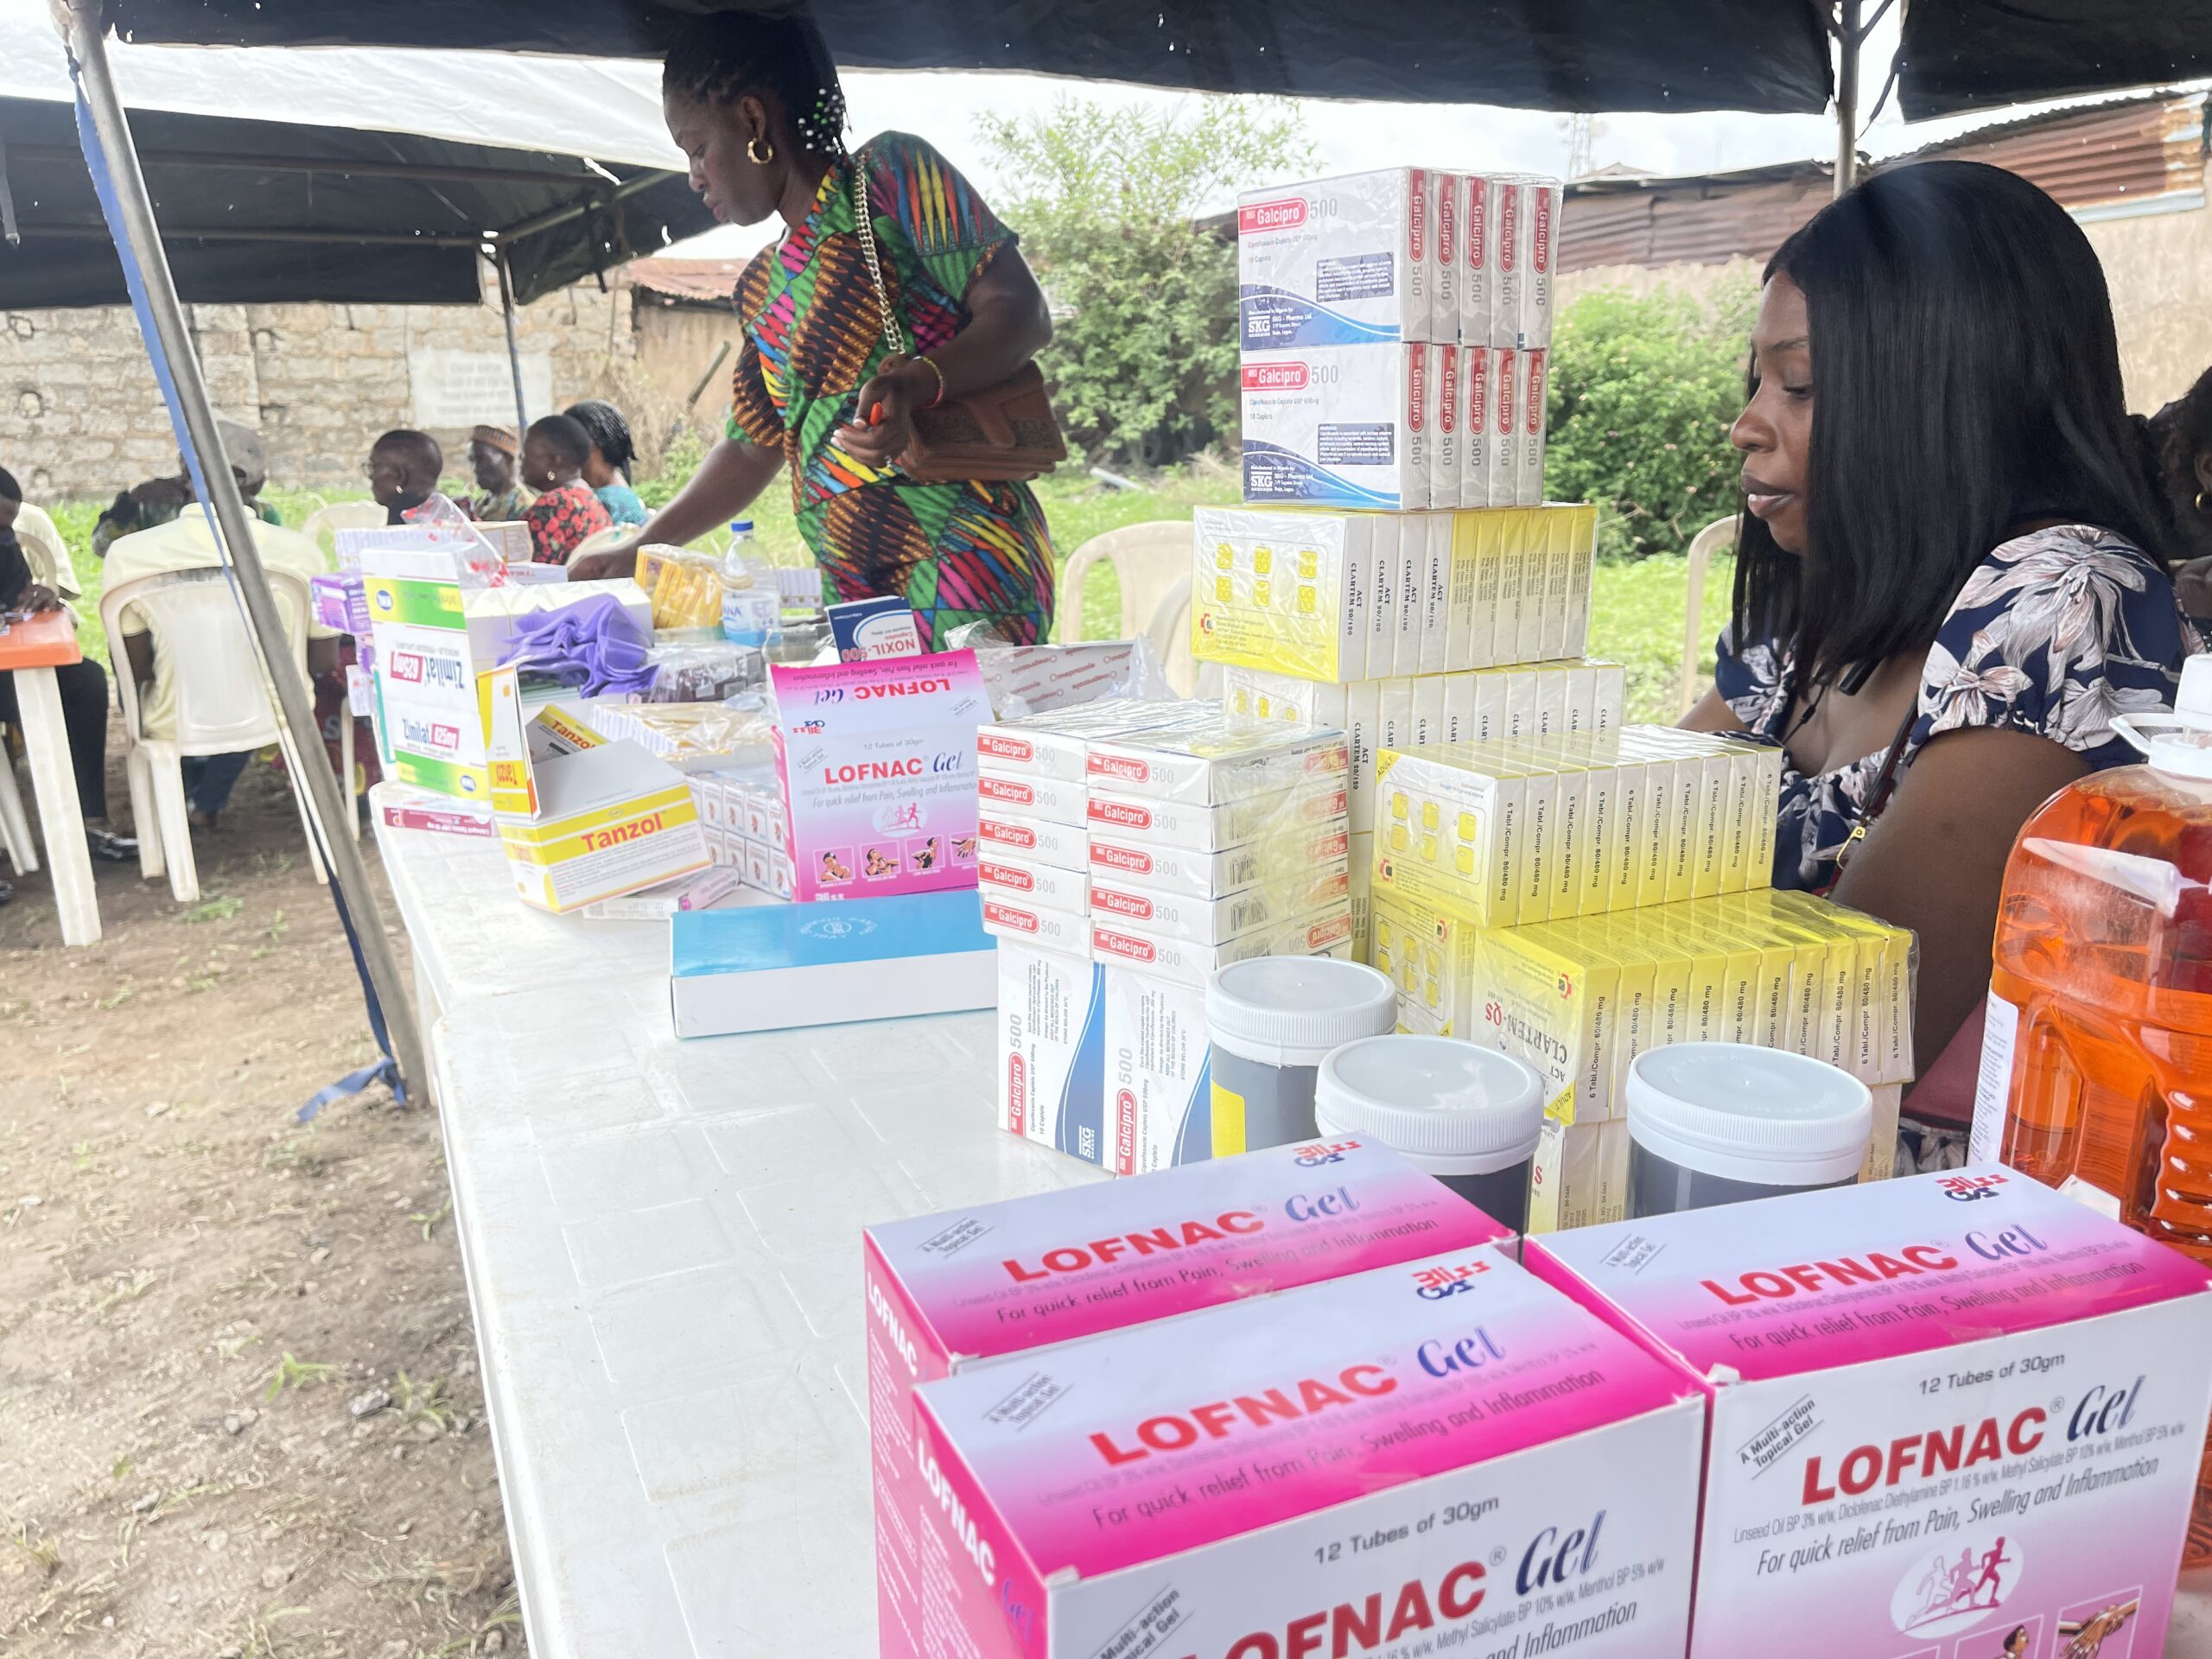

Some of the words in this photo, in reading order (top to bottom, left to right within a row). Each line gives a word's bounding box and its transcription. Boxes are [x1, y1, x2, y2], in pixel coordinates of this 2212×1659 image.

[1256, 207, 1300, 225] Galcipro
[1310, 198, 1338, 219] 500
[1412, 196, 1423, 250] Galcipro
[1441, 200, 1452, 254] Galcipro
[1471, 206, 1484, 258] Galcipro
[1503, 209, 1514, 262] Galcipro
[1537, 212, 1548, 263] Galcipro
[1412, 266, 1422, 296] 500
[1441, 270, 1452, 300] 500
[1472, 274, 1482, 303] 500
[1503, 276, 1512, 305] 500
[1536, 278, 1546, 306] 500
[1249, 321, 1270, 334] SKG
[1259, 369, 1300, 385] Galcipro
[1312, 365, 1338, 384] 500
[1411, 369, 1422, 421] Galcipro
[1443, 371, 1454, 423] Galcipro
[1472, 372, 1484, 423] Galcipro
[1500, 374, 1512, 424] Galcipro
[1529, 376, 1541, 424] Galcipro
[1412, 436, 1421, 465] 500
[1443, 437, 1452, 466] 500
[1472, 438, 1482, 467] 500
[1501, 438, 1510, 466] 500
[1528, 438, 1537, 466] 500
[1251, 476, 1273, 487] SKG
[1430, 557, 1439, 600] CLARTEM
[393, 655, 420, 679] 625mg
[814, 689, 843, 705] Gel
[855, 678, 950, 700] LOFNAC
[402, 719, 430, 744] Zimilat
[434, 726, 459, 750] 625mg
[992, 740, 1027, 757] Galcipro
[1035, 747, 1055, 762] 500
[824, 758, 923, 785] LOFNAC
[933, 751, 963, 772] Gel
[1103, 759, 1141, 778] Galcipro
[1152, 767, 1173, 784] 500
[1377, 756, 1393, 778] ADULT
[897, 787, 923, 799] Swelling
[925, 785, 938, 794] and
[993, 783, 1028, 801] Galcipro
[1037, 791, 1056, 806] 500
[582, 812, 664, 852] Tanzol
[1104, 805, 1144, 823] Galcipro
[1154, 816, 1176, 830] 500
[1535, 807, 1544, 855] Tabl./Compr.
[1624, 797, 1634, 844] Tabl./Compr.
[995, 826, 1030, 844] Galcipro
[1038, 835, 1058, 850] 500
[1503, 810, 1513, 859] Tabl./Compr.
[1106, 849, 1145, 869] Galcipro
[1154, 860, 1178, 876] 500
[994, 869, 1028, 887] Galcipro
[1036, 879, 1055, 893] 500
[1531, 885, 1538, 897] mg
[1621, 873, 1627, 885] mg
[1107, 893, 1146, 914] Galcipro
[1155, 906, 1178, 923] 500
[1500, 888, 1506, 901] mg
[998, 911, 1033, 928] Galcipro
[1040, 922, 1060, 937] 500
[1109, 937, 1148, 957] Galcipro
[1158, 950, 1180, 966] 500
[1865, 968, 1872, 980] mg
[1861, 982, 1870, 1007] 80/480
[1010, 1014, 1021, 1048] 500
[1861, 1010, 1870, 1058] Tabl./Compr.
[1119, 1048, 1132, 1084] 500
[1550, 1065, 1565, 1082] ACT
[1012, 1064, 1022, 1116] Galcipro
[1555, 1091, 1572, 1110] ADULT
[1120, 1101, 1133, 1156] Galcipro
[1001, 1211, 1264, 1283] LOFNAC
[1285, 1186, 1360, 1222] Gel
[1699, 1245, 1957, 1306] LOFNAC
[1964, 1224, 2048, 1261] Gel
[1728, 1333, 1762, 1351] For
[1764, 1323, 1815, 1350] quick
[1814, 1313, 1855, 1337] relief
[1855, 1306, 1899, 1328] from
[1899, 1298, 1947, 1321] Pain,
[1943, 1287, 2018, 1313] Swelling
[2020, 1277, 2046, 1297] and
[2040, 1260, 2147, 1291] Inflammation
[867, 1271, 918, 1376] LOFNAC
[1919, 1378, 1941, 1395] 12
[1948, 1370, 1993, 1390] Tubes
[1999, 1362, 2014, 1378] of
[2019, 1354, 2065, 1374] 30gm
[1088, 1364, 1397, 1467] LOFNAC
[1417, 1325, 1506, 1377] Gel
[1360, 1418, 1449, 1452] Swelling
[1448, 1402, 1484, 1426] and
[1483, 1370, 1606, 1415] Inflammation
[1740, 1452, 1750, 1465] A
[1750, 1399, 1815, 1454] Multi-action
[1753, 1433, 1794, 1468] Topical
[1795, 1414, 1814, 1435] Gel
[1802, 1407, 2047, 1506] LOFNAC
[2067, 1375, 2146, 1442] Gel
[918, 1438, 995, 1586] LOFNAC
[1757, 1548, 1785, 1576] For
[1789, 1534, 1833, 1573] quick
[1838, 1520, 1881, 1557] relief
[1882, 1516, 1921, 1546] from
[1923, 1506, 1961, 1535] Pain,
[1967, 1490, 2031, 1523] Swelling
[2033, 1474, 2064, 1504] and
[2064, 1455, 2159, 1497] Inflammation
[1772, 1519, 1784, 1535] Oil
[1786, 1516, 1801, 1532] BP
[1802, 1513, 1815, 1529] 3%
[1314, 1543, 1341, 1565] 12
[1350, 1526, 1409, 1554] Tubes
[1416, 1512, 1435, 1535] of
[1443, 1497, 1500, 1525] 30gm
[1179, 1560, 1486, 1659] FNAC
[1515, 1509, 1607, 1596] Gel
[1522, 1601, 1637, 1659] Inflammation
